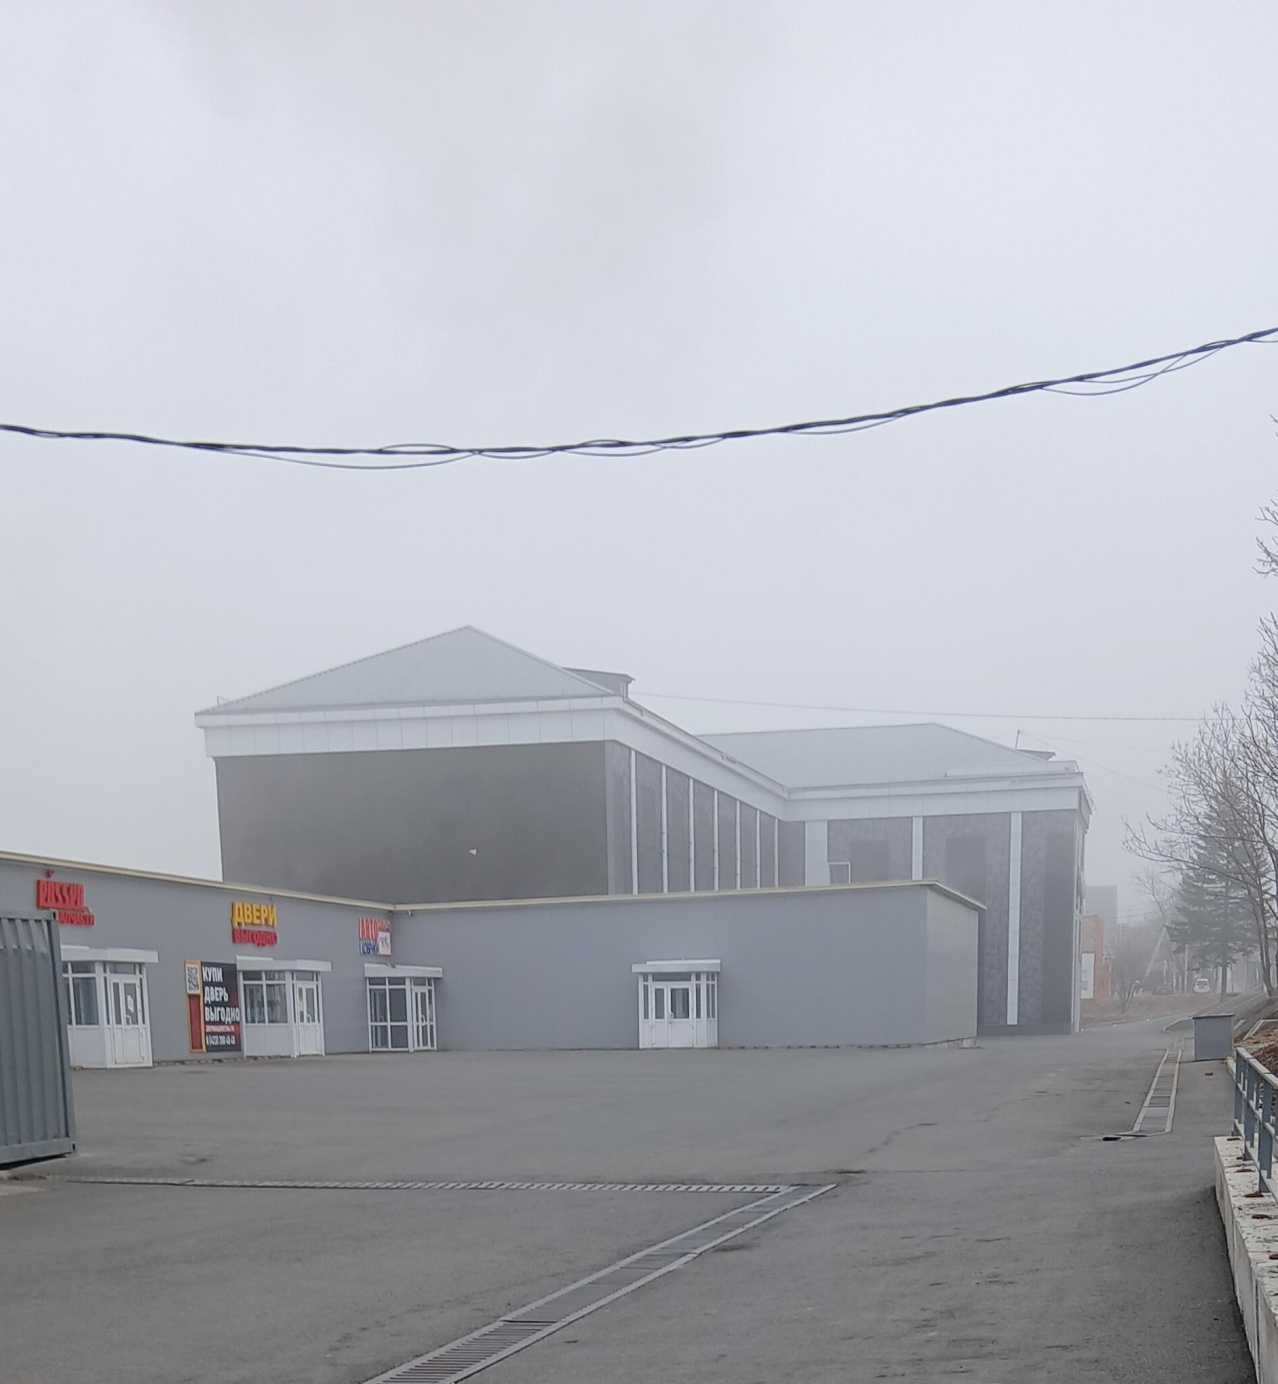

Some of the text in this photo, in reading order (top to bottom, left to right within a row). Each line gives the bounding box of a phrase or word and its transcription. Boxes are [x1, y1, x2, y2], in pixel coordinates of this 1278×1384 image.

[231, 902, 277, 928] ДВЕРИ
[232, 929, 278, 947] ВЫГОДНО
[203, 966, 223, 983] КУПИ
[204, 986, 229, 1004] ДВЕРЬ
[205, 1007, 240, 1024] ВЫГОДНО
